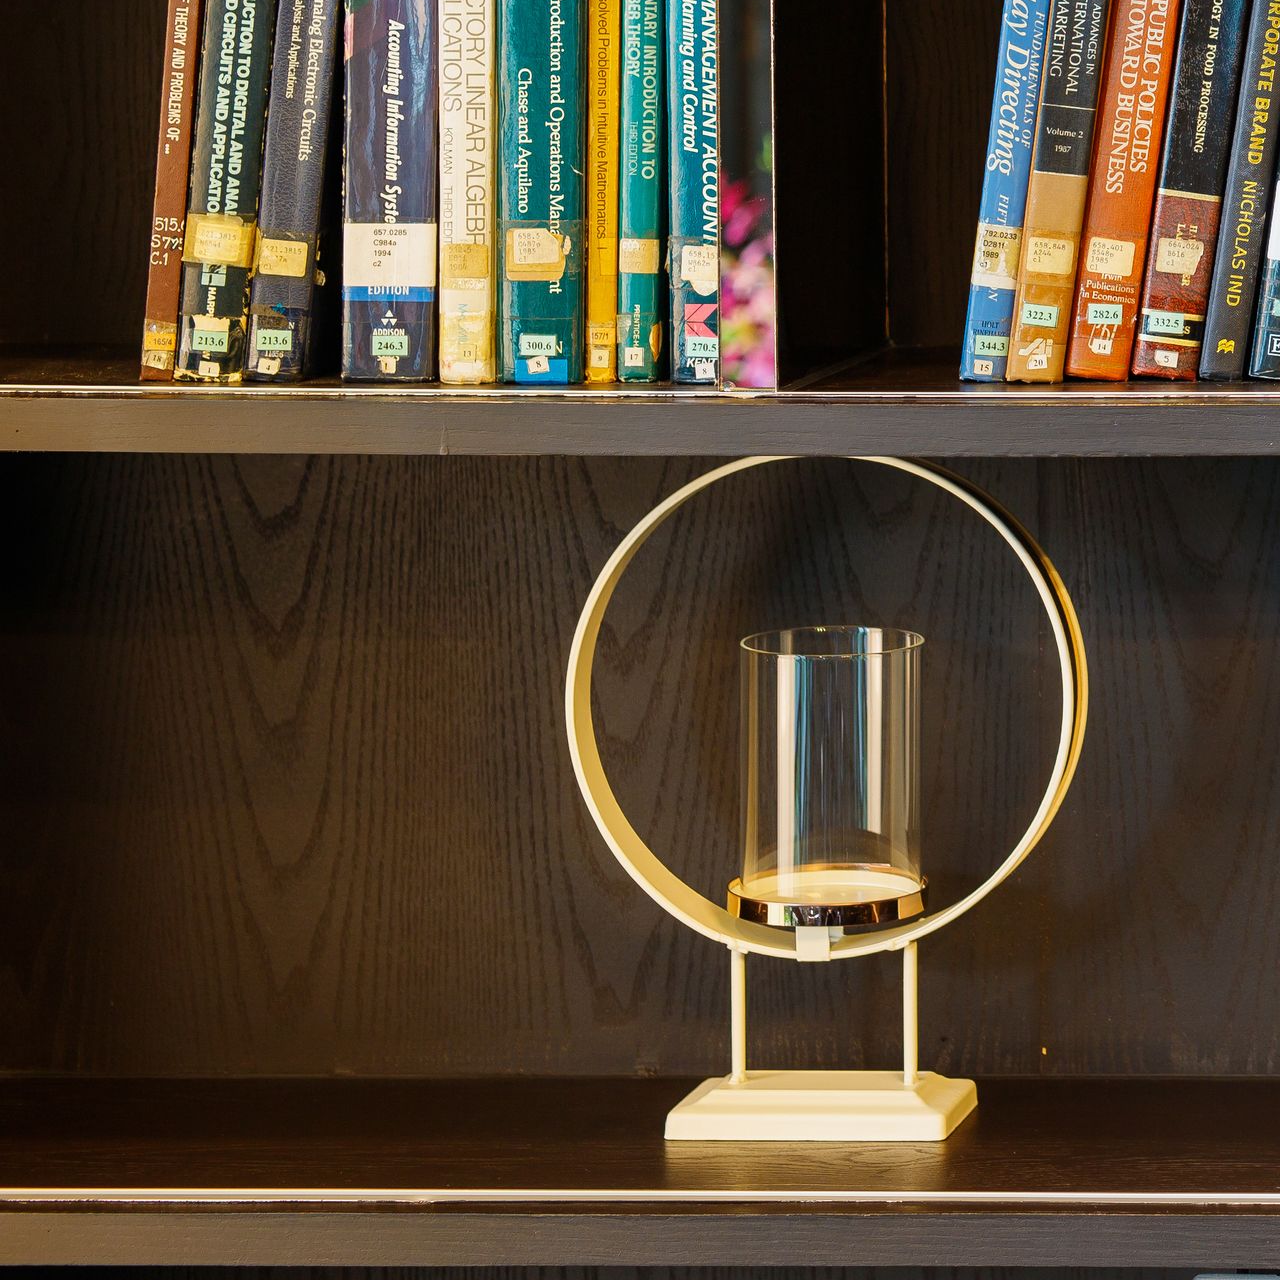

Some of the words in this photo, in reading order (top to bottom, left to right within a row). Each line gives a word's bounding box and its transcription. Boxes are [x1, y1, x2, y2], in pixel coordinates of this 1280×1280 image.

[304, 38, 322, 105] Electronic
[383, 20, 405, 95] Accounting
[627, 25, 640, 77] THEORY
[297, 110, 318, 161] Circuits
[385, 99, 402, 180] Information
[987, 41, 1028, 175] Directing
[1106, 94, 1132, 193] BUSINESS
[1132, 79, 1157, 172] POLICIES
